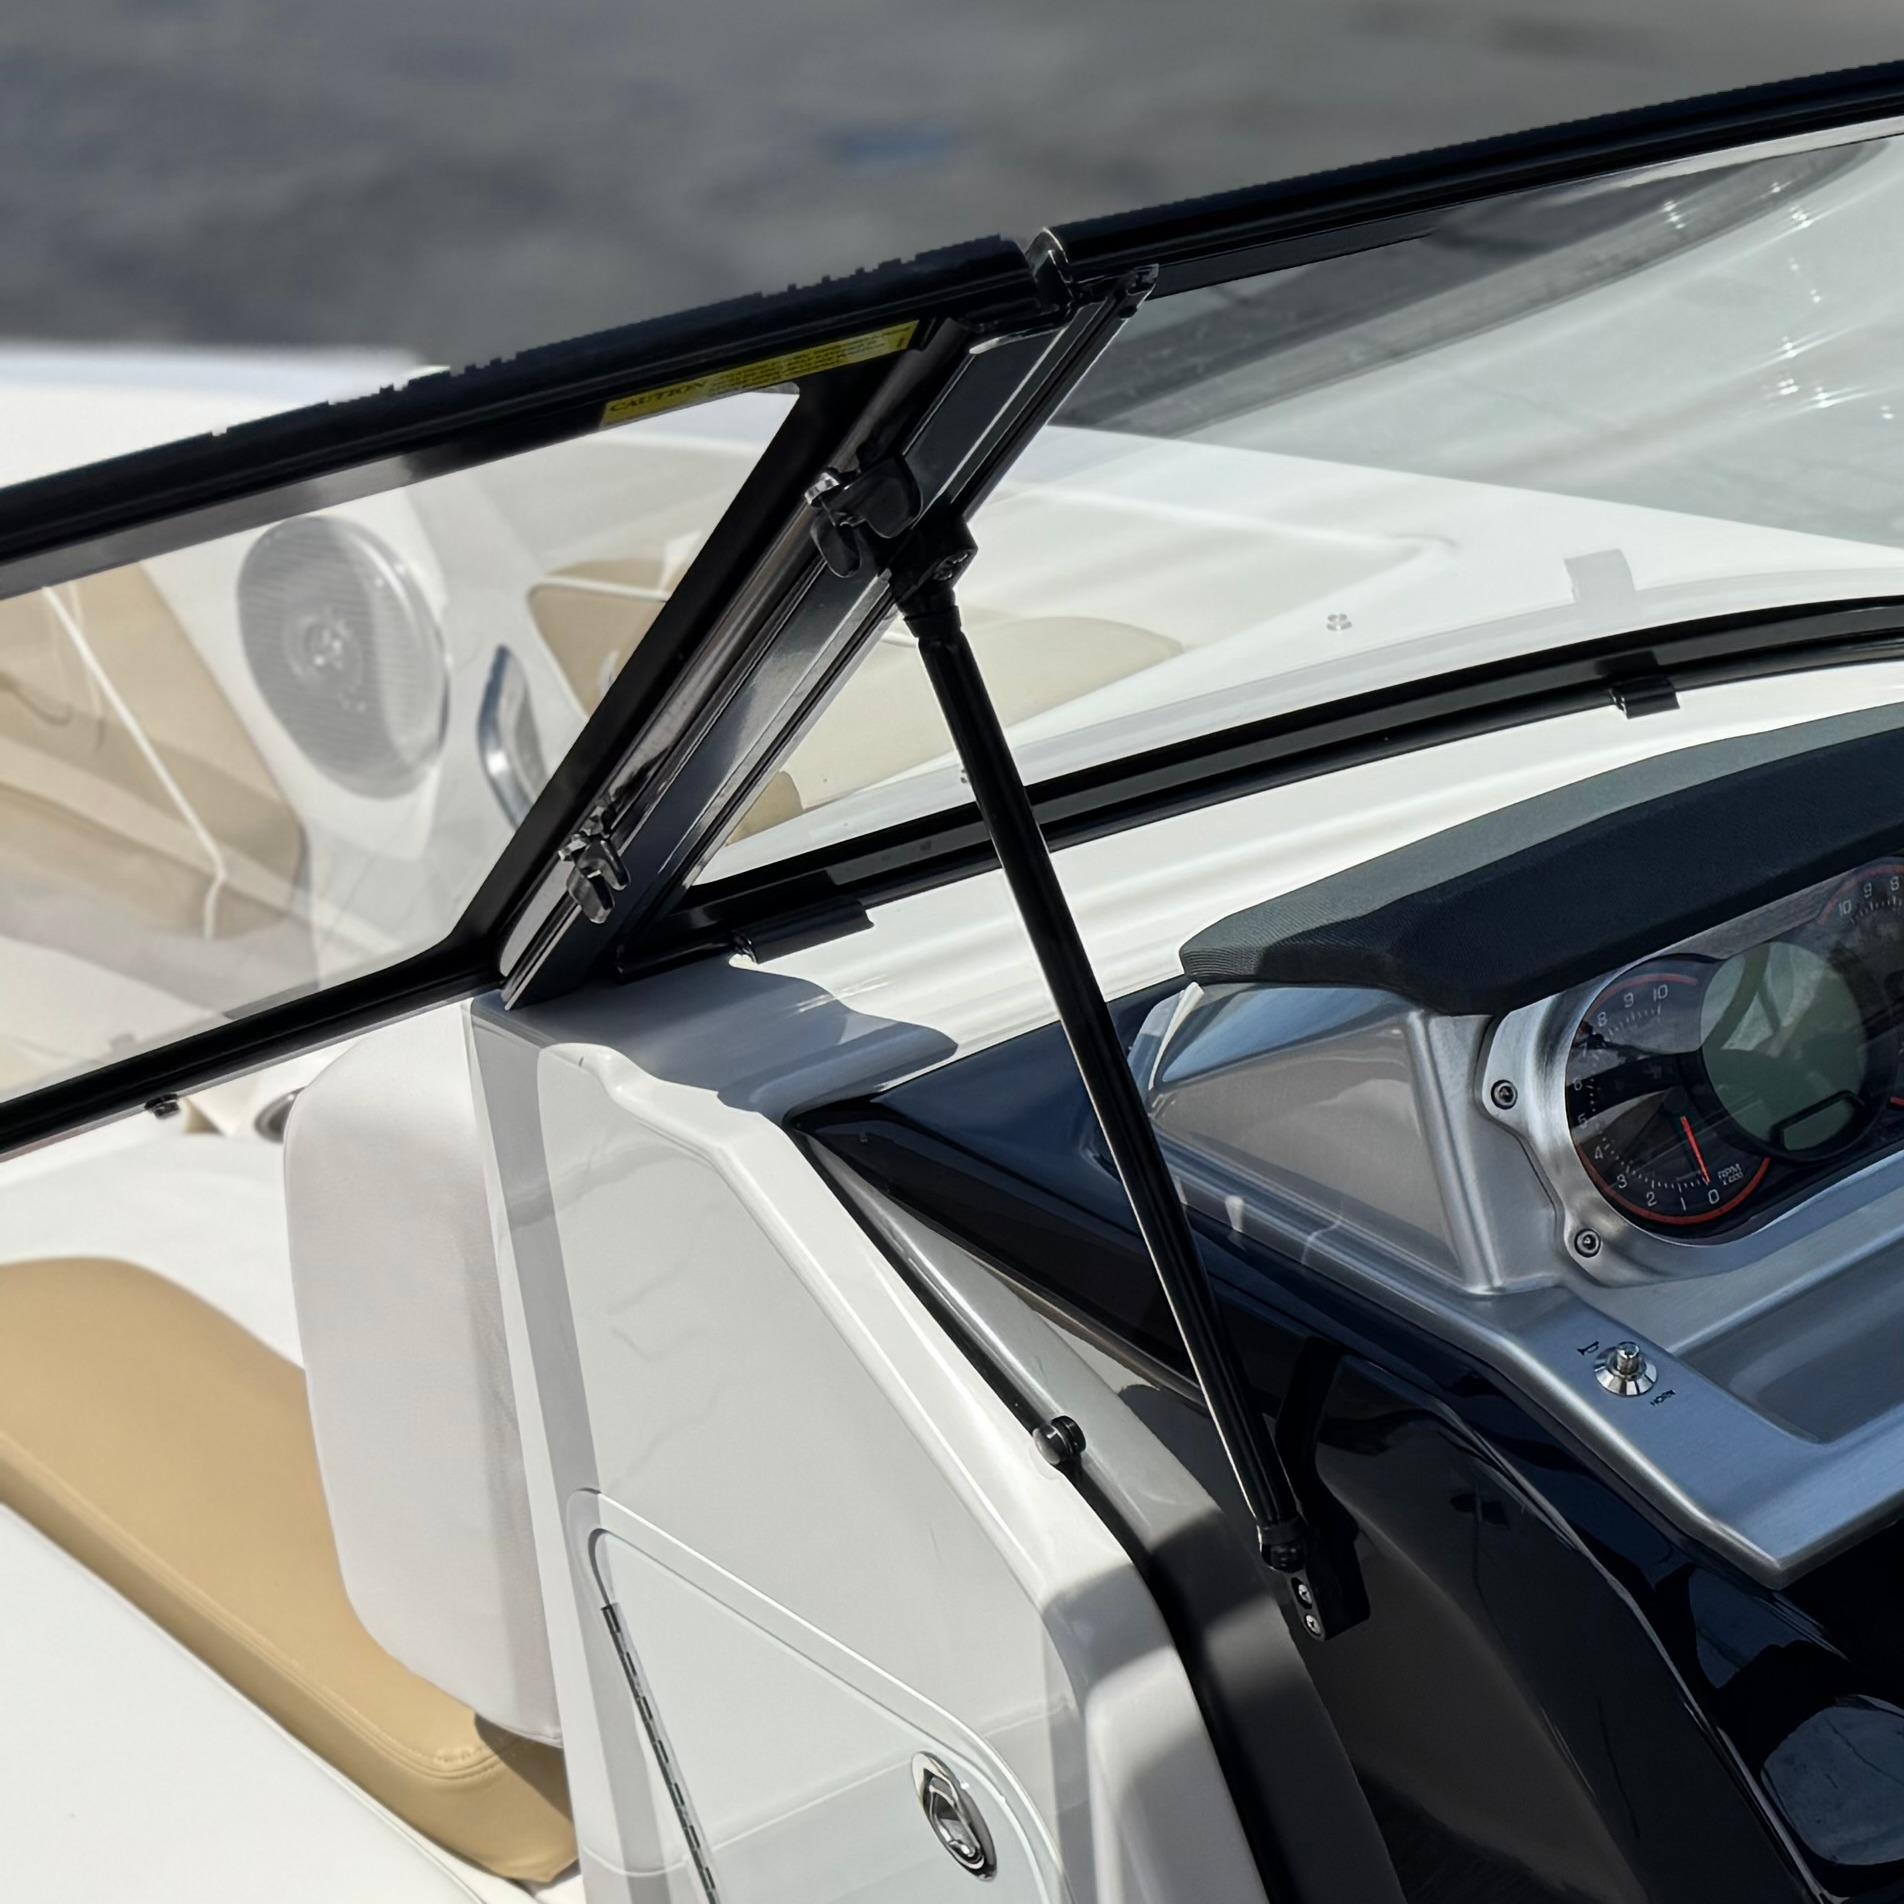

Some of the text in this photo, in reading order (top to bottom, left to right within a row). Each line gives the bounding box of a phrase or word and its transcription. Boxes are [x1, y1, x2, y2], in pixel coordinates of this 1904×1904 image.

[1863, 882, 1873, 898] 9
[1890, 876, 1900, 890] 8
[1837, 900, 1852, 917] 10
[1623, 992, 1634, 1008] 9
[1653, 984, 1668, 1001] 10
[1597, 1011, 1608, 1027] 8
[1573, 1080, 1583, 1091] 6
[1577, 1114, 1588, 1129] 5
[1594, 1145, 1605, 1160] 4
[1617, 1174, 1629, 1189] 3
[1646, 1191, 1657, 1207] 2
[1708, 1188, 1720, 1205] 0
